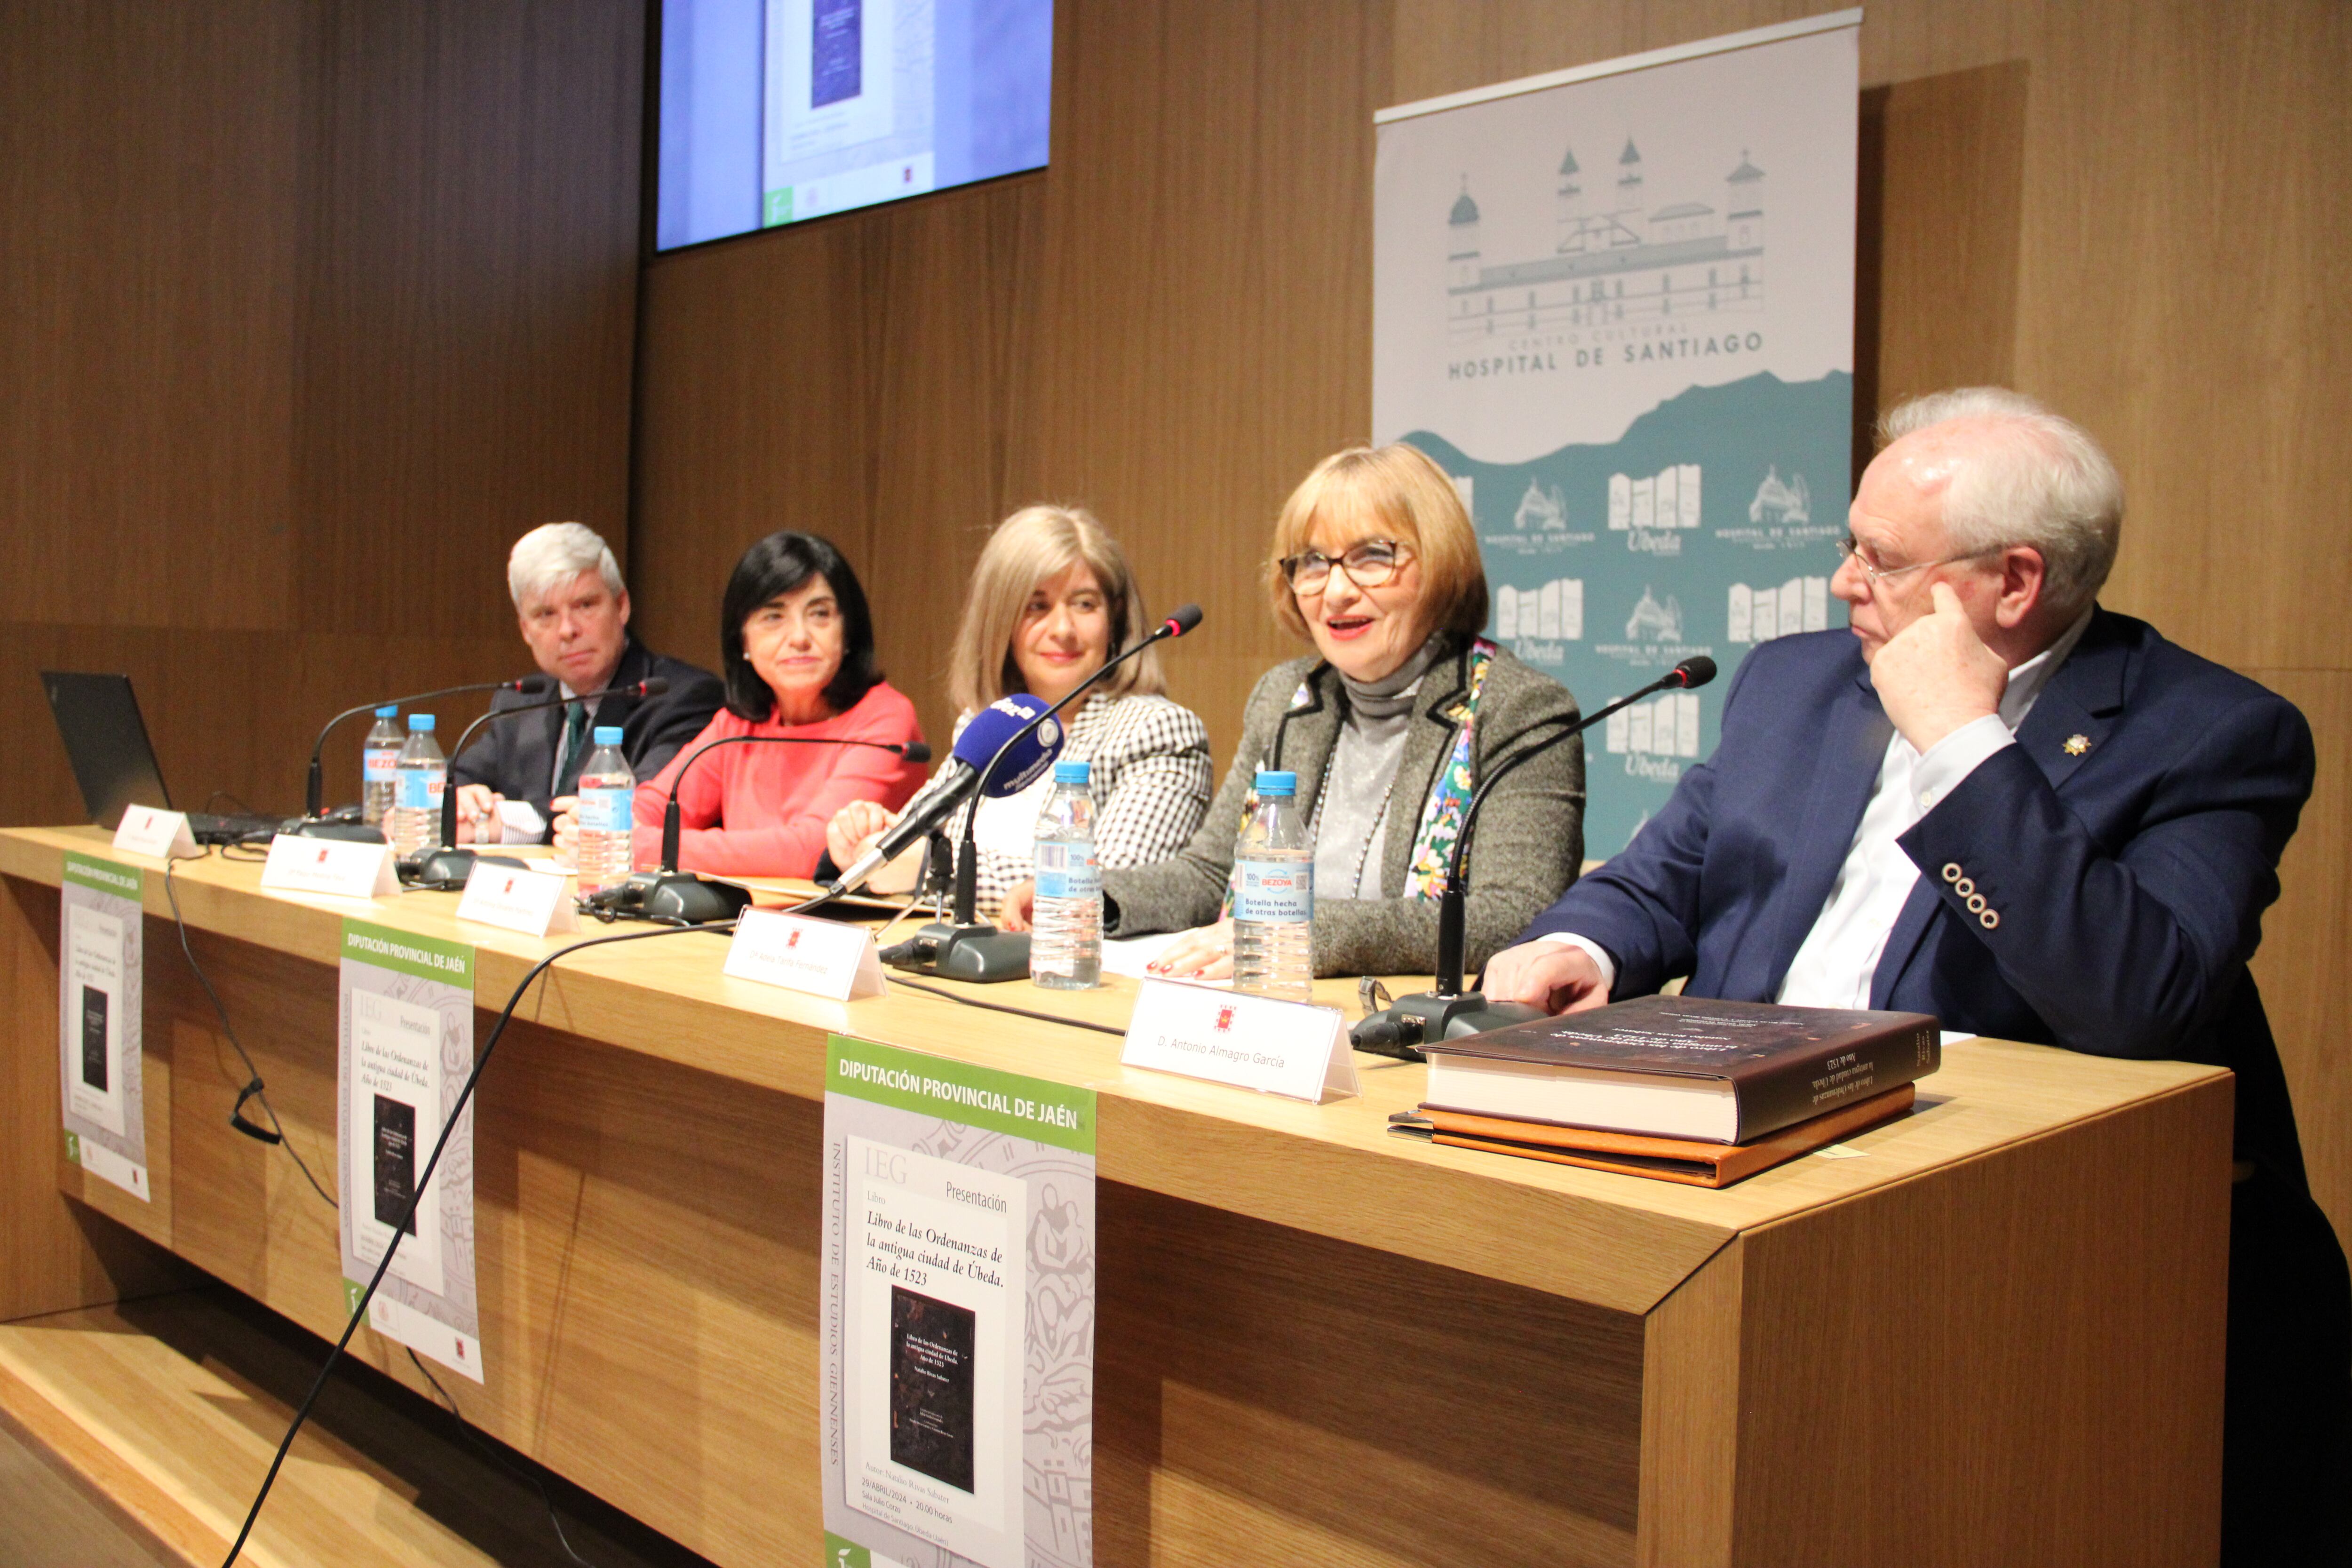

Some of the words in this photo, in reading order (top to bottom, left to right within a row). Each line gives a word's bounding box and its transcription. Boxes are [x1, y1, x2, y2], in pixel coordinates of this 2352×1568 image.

[1449, 353, 1556, 379] HOSPITAL
[1576, 348, 1604, 367] DE
[1624, 332, 1762, 363] SANTIAGO
[1509, 334, 1579, 352] CENTRO
[368, 758, 397, 769] BEZO
[1246, 898, 1271, 907] Botella
[348, 932, 389, 955] DIPUTACIÓN
[389, 942, 433, 966] PROVINCIAL
[434, 953, 445, 969] DE
[445, 955, 466, 974] JAÉN
[362, 1040, 374, 1054] Libro
[376, 1045, 381, 1056] de
[391, 1050, 421, 1068] Ordenanzas
[423, 1060, 429, 1071] de
[1158, 1036, 1167, 1048] D.
[1170, 1038, 1207, 1055] Antonio
[1209, 1044, 1250, 1063] Almagro
[1253, 1052, 1285, 1069] García
[1827, 1058, 1840, 1071] 1523
[361, 1056, 366, 1067] la
[367, 1061, 385, 1075] antigua
[387, 1066, 404, 1079] ciudad
[405, 1071, 410, 1082] de
[361, 1072, 372, 1085] Año
[373, 1077, 379, 1087] de
[380, 1079, 392, 1092] 1523
[839, 1058, 920, 1094] DIPUTACIÓN
[923, 1077, 1011, 1114] PROVINCIAL
[1014, 1098, 1035, 1120] DE
[1037, 1104, 1077, 1130] JAÉN
[865, 1146, 908, 1185] IEG
[832, 1142, 841, 1236] INSTITUTO
[867, 1190, 886, 1205] Libro
[946, 1181, 1007, 1213] Presentación
[867, 1210, 893, 1230] Libro
[896, 1219, 906, 1234] de
[909, 1223, 922, 1240] las
[926, 1228, 988, 1259] Ordenanzas
[991, 1247, 1003, 1264] de
[831, 1243, 840, 1266] DE
[867, 1232, 876, 1247] la
[879, 1241, 914, 1260] antigua
[918, 1250, 951, 1271] ciudad
[953, 1259, 964, 1275] de
[968, 1260, 1004, 1288] Úbeda.
[866, 1256, 887, 1274] Año
[890, 1263, 901, 1278] de
[904, 1267, 928, 1286] 1523
[829, 1273, 839, 1356] ESTUDIOS
[906, 1333, 918, 1342] Libro
[929, 1341, 953, 1355] Ordenanzas
[910, 1344, 925, 1353] antigua
[925, 1348, 938, 1358] ciudad
[914, 1366, 927, 1375] Natalio
[927, 1370, 937, 1379] Rivas
[936, 1374, 950, 1383] Sabater
[934, 1359, 945, 1368] 1523
[829, 1362, 839, 1466] GIENNENSES
[866, 1461, 885, 1476] Autor:
[885, 1470, 907, 1486] Natalio
[909, 1479, 926, 1494] Rivas
[927, 1488, 949, 1504] Sabater
[862, 1477, 907, 1504] 29/ABRIL/2024
[916, 1501, 933, 1516] 20.00
[934, 1508, 953, 1524] horas
[862, 1490, 873, 1501] Sala
[874, 1496, 885, 1506] Julio
[885, 1501, 901, 1513] Corzo
[862, 1503, 883, 1518] Hospital
[884, 1512, 890, 1520] de
[915, 1525, 932, 1539] Úbeda
[933, 1532, 949, 1547] (Jaén)
